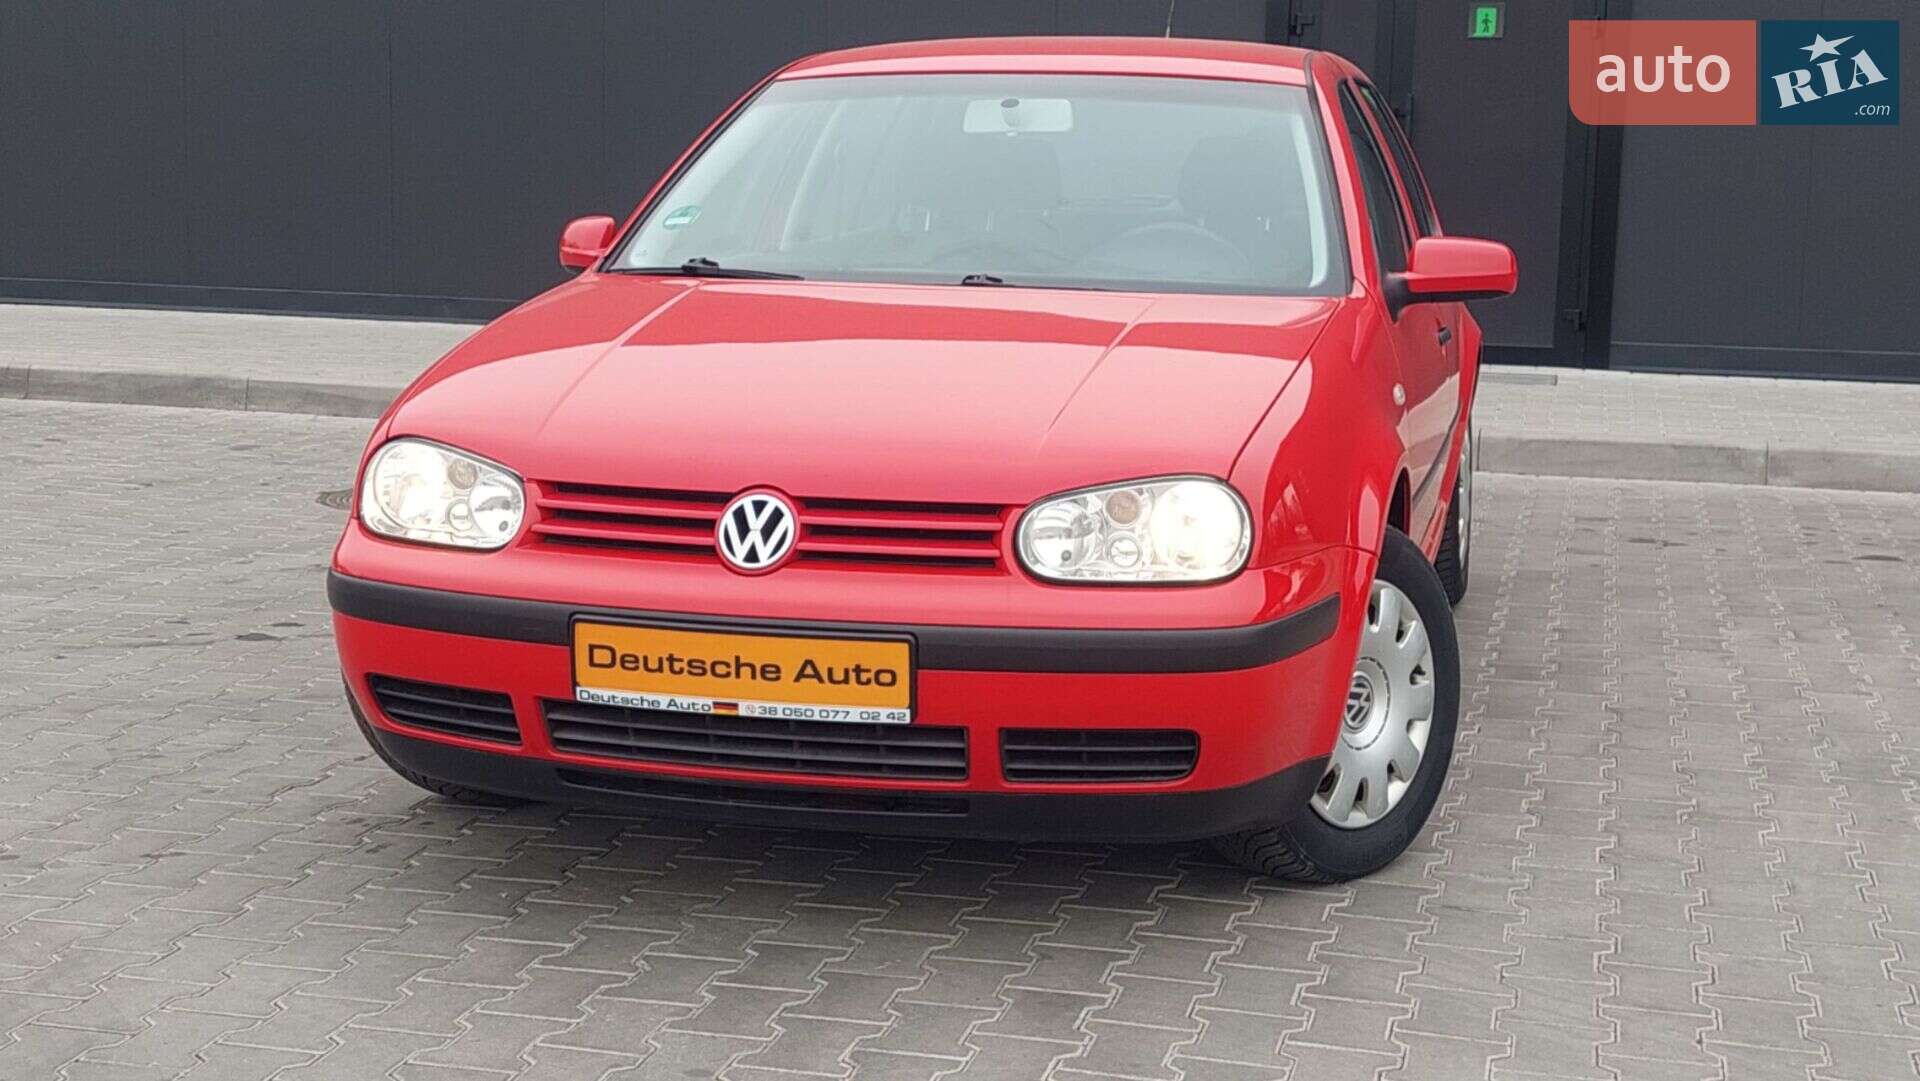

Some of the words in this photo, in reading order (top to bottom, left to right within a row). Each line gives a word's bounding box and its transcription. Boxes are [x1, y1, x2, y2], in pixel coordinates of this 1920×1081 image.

[588, 644, 782, 682] Deutsche
[793, 658, 898, 687] Auto
[579, 689, 661, 708] Deutsche
[666, 698, 712, 712] Auto
[819, 709, 850, 720] 077
[859, 711, 881, 721] 02
[886, 712, 907, 722] 42
